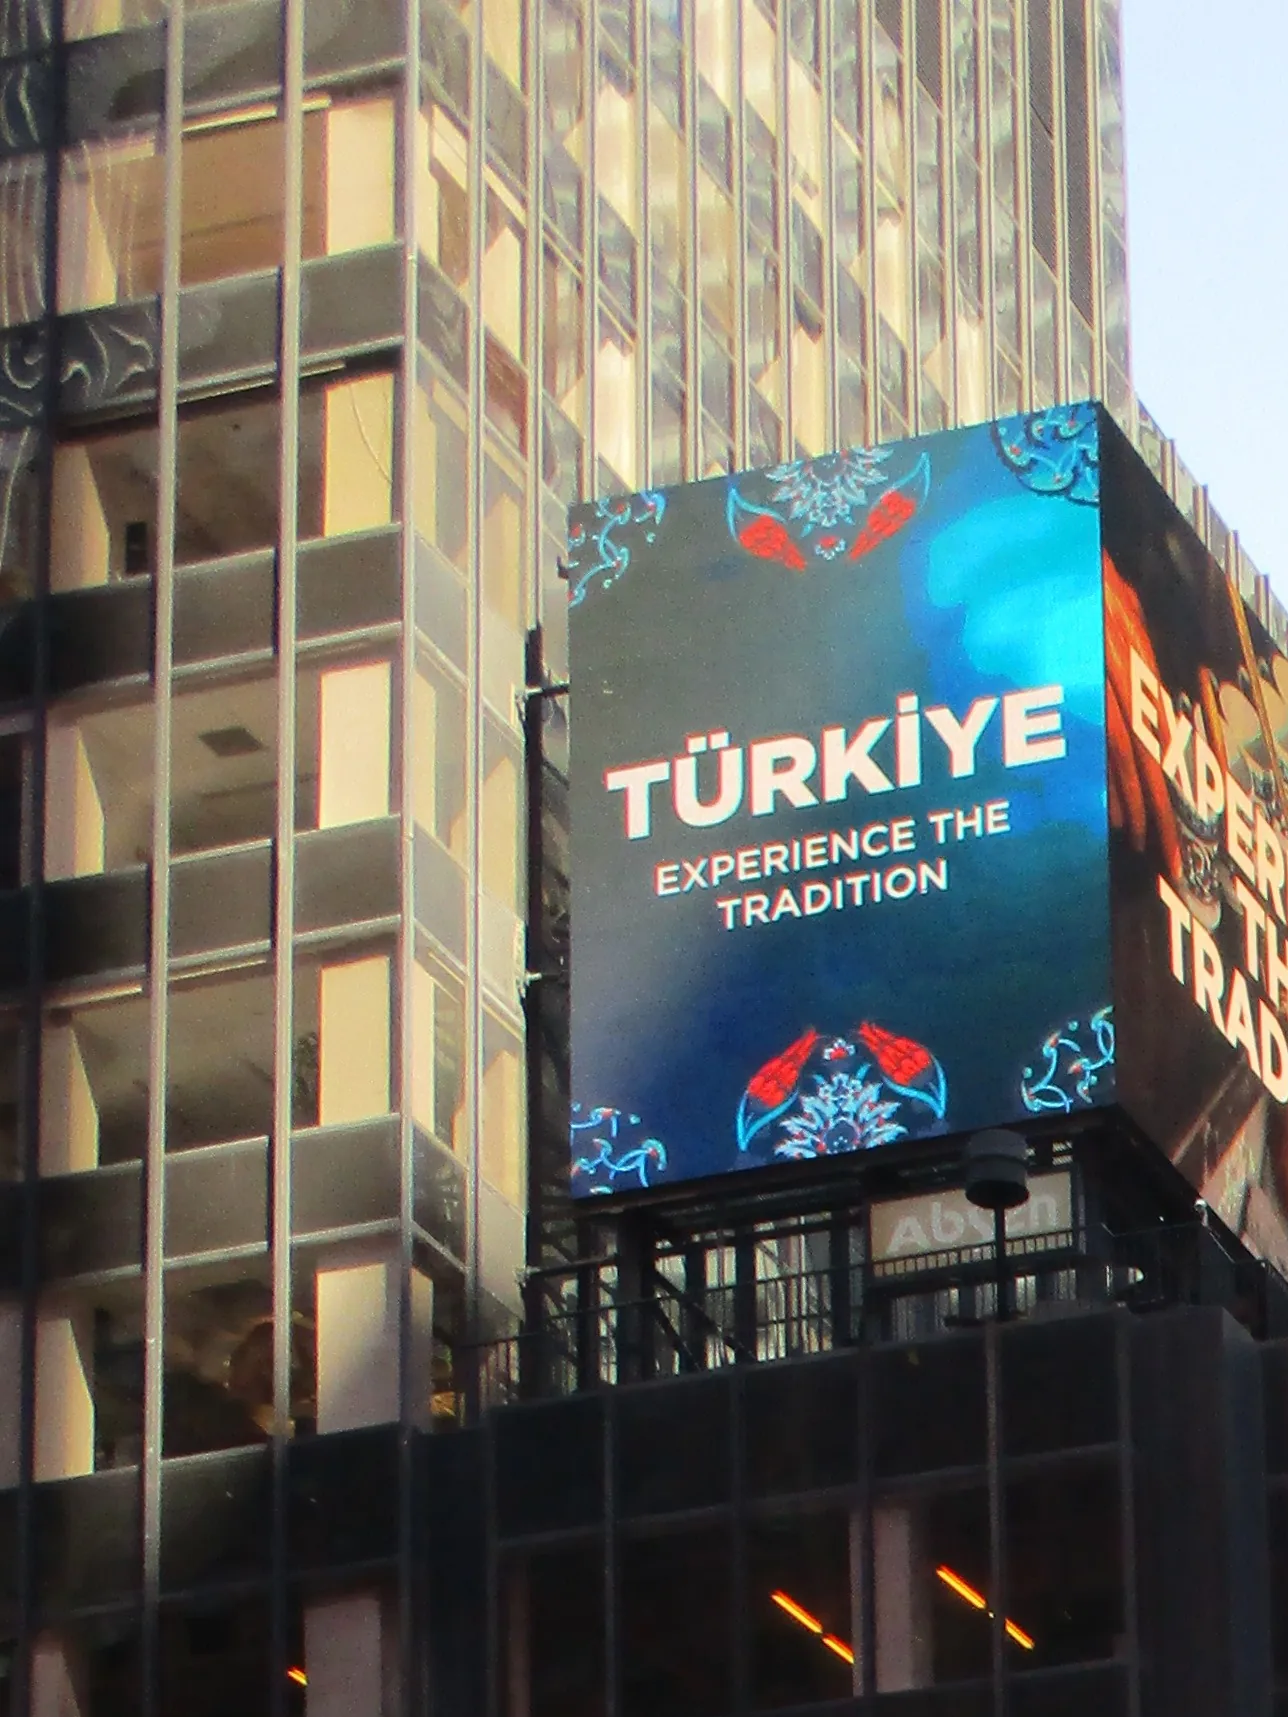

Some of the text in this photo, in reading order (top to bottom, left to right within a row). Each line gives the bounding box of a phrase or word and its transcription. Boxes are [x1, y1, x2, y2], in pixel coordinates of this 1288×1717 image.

[605, 685, 1066, 840] TÜRKİYE
[654, 801, 1010, 897] EXPERIENCE THE
[718, 857, 947, 930] TRADITION
